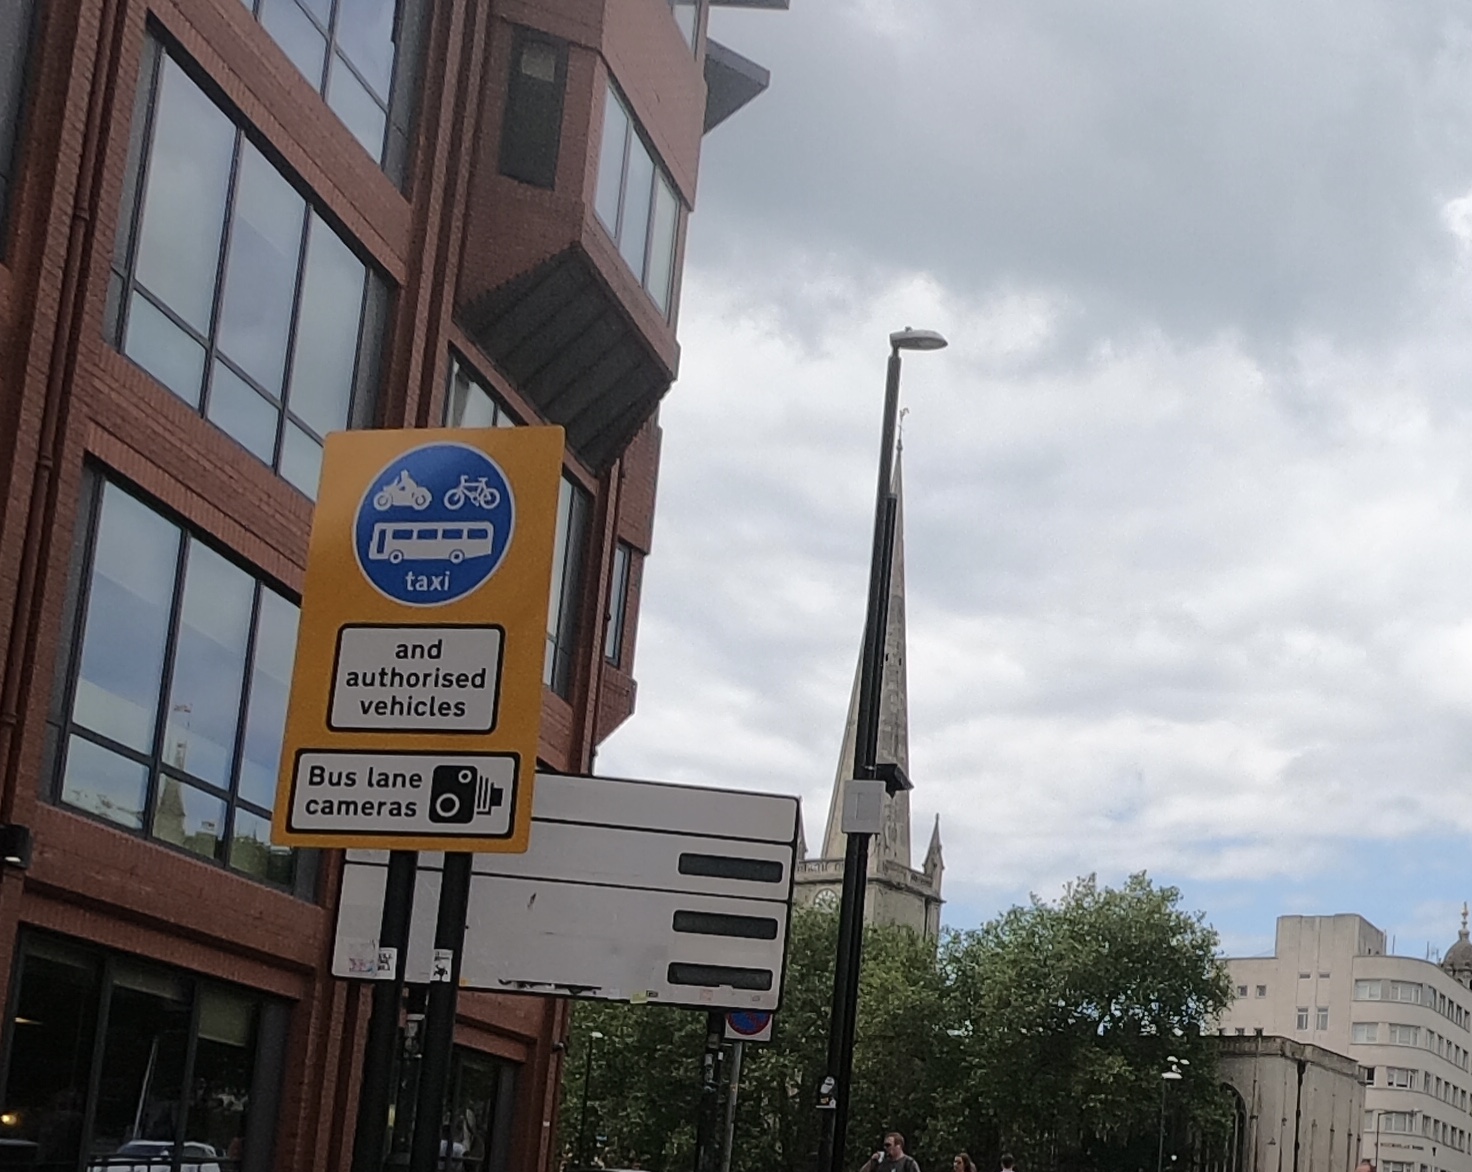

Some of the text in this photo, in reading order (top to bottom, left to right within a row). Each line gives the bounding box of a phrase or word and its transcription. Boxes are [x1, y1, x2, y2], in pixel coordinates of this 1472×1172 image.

[405, 570, 450, 592] taxi
[394, 639, 442, 660] and
[345, 667, 487, 690] authorised
[359, 695, 466, 718] vehicles
[307, 765, 423, 789] Bus lane
[304, 798, 418, 818] cameras
